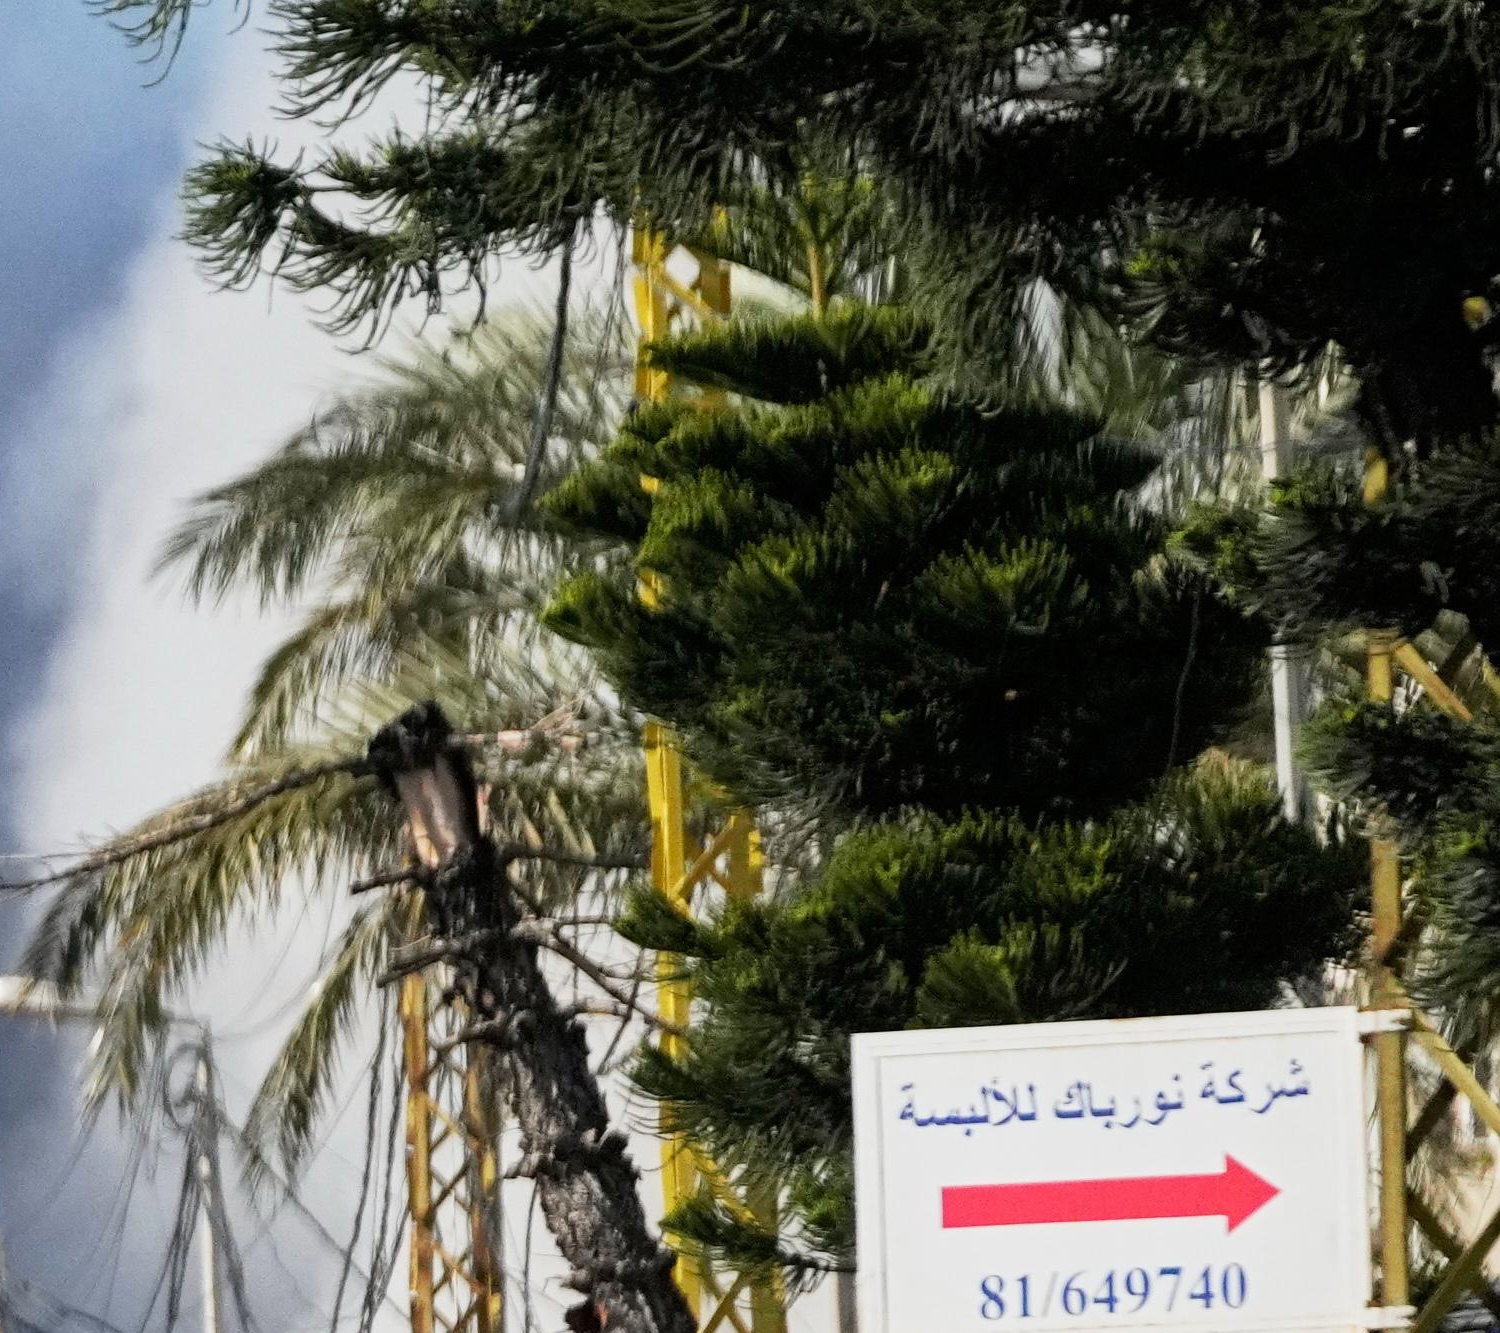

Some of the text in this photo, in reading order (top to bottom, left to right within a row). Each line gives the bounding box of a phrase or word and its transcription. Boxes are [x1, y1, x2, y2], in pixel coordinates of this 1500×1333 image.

[899, 1058, 1311, 1137] شركة نورباك للألبسة
[979, 1262, 1248, 1321] 81/649740
